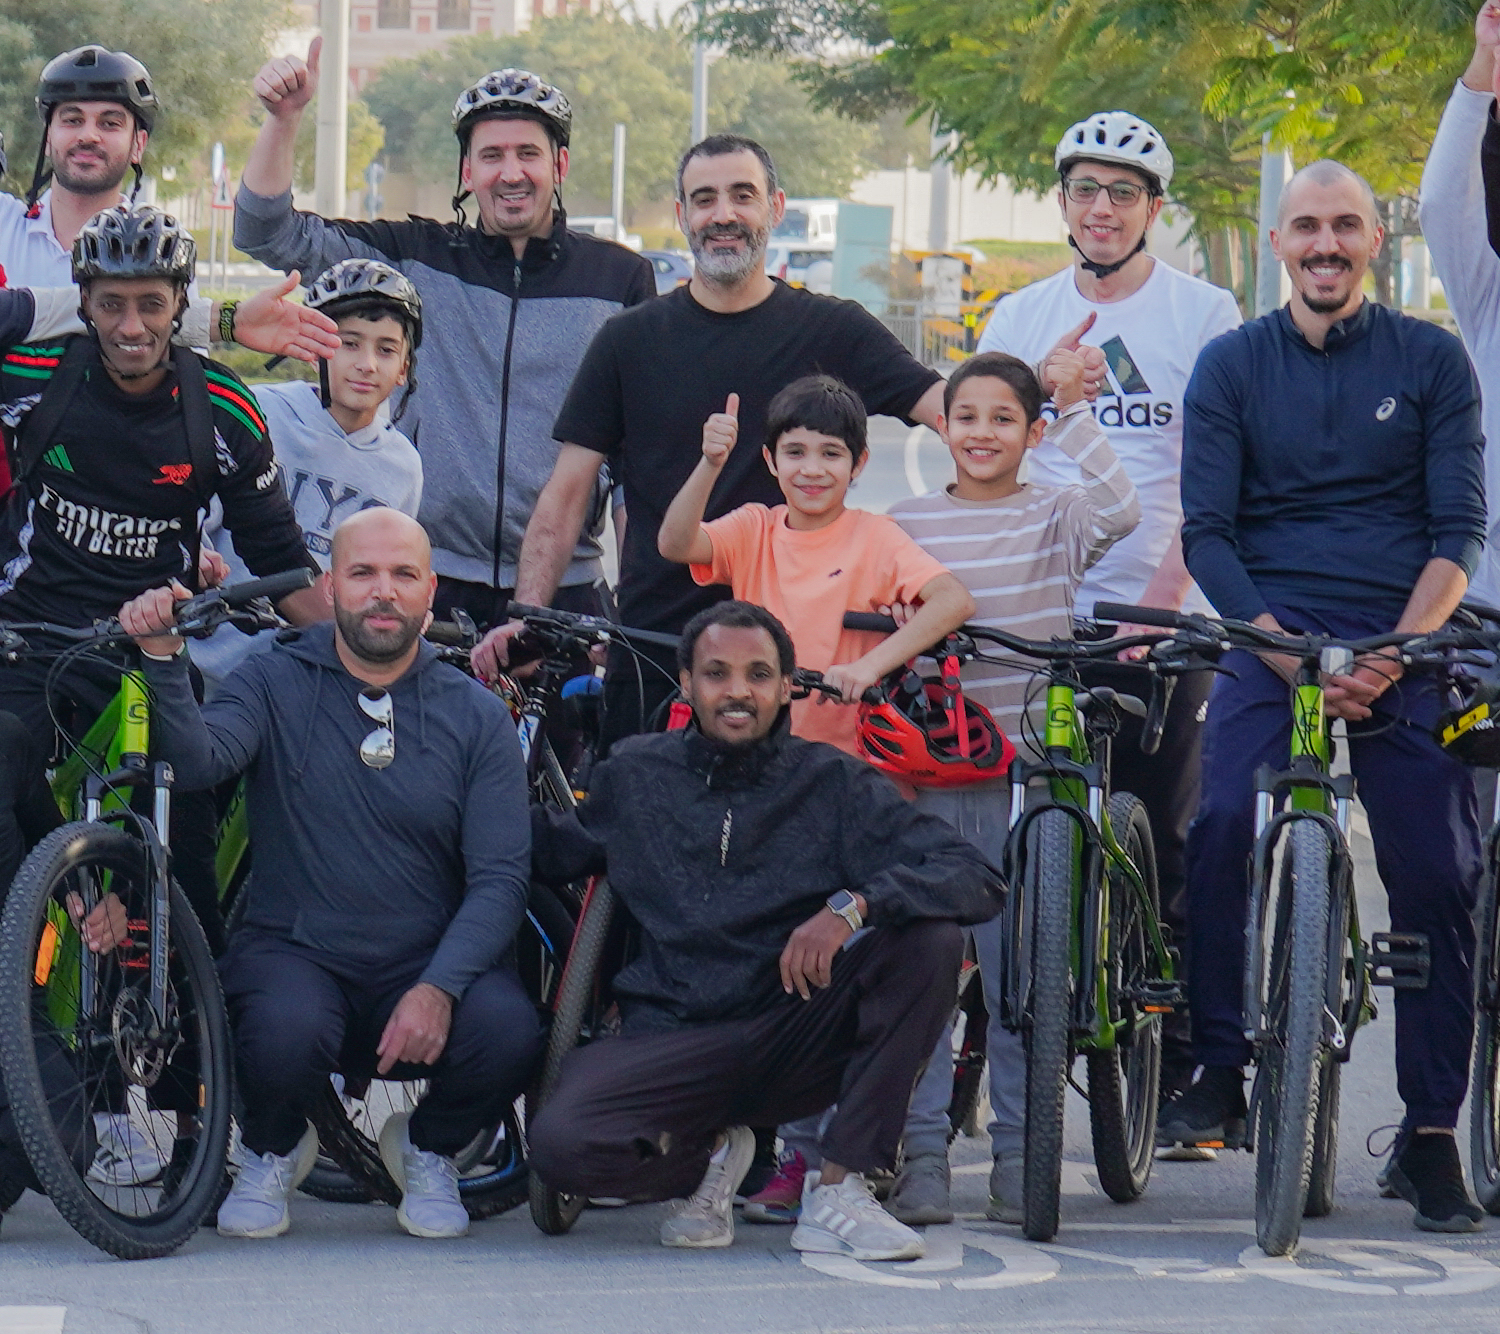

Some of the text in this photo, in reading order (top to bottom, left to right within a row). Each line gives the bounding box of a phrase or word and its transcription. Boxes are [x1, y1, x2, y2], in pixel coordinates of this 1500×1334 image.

[38, 482, 182, 539] Emirates
[56, 516, 159, 559] FLY BETTER
